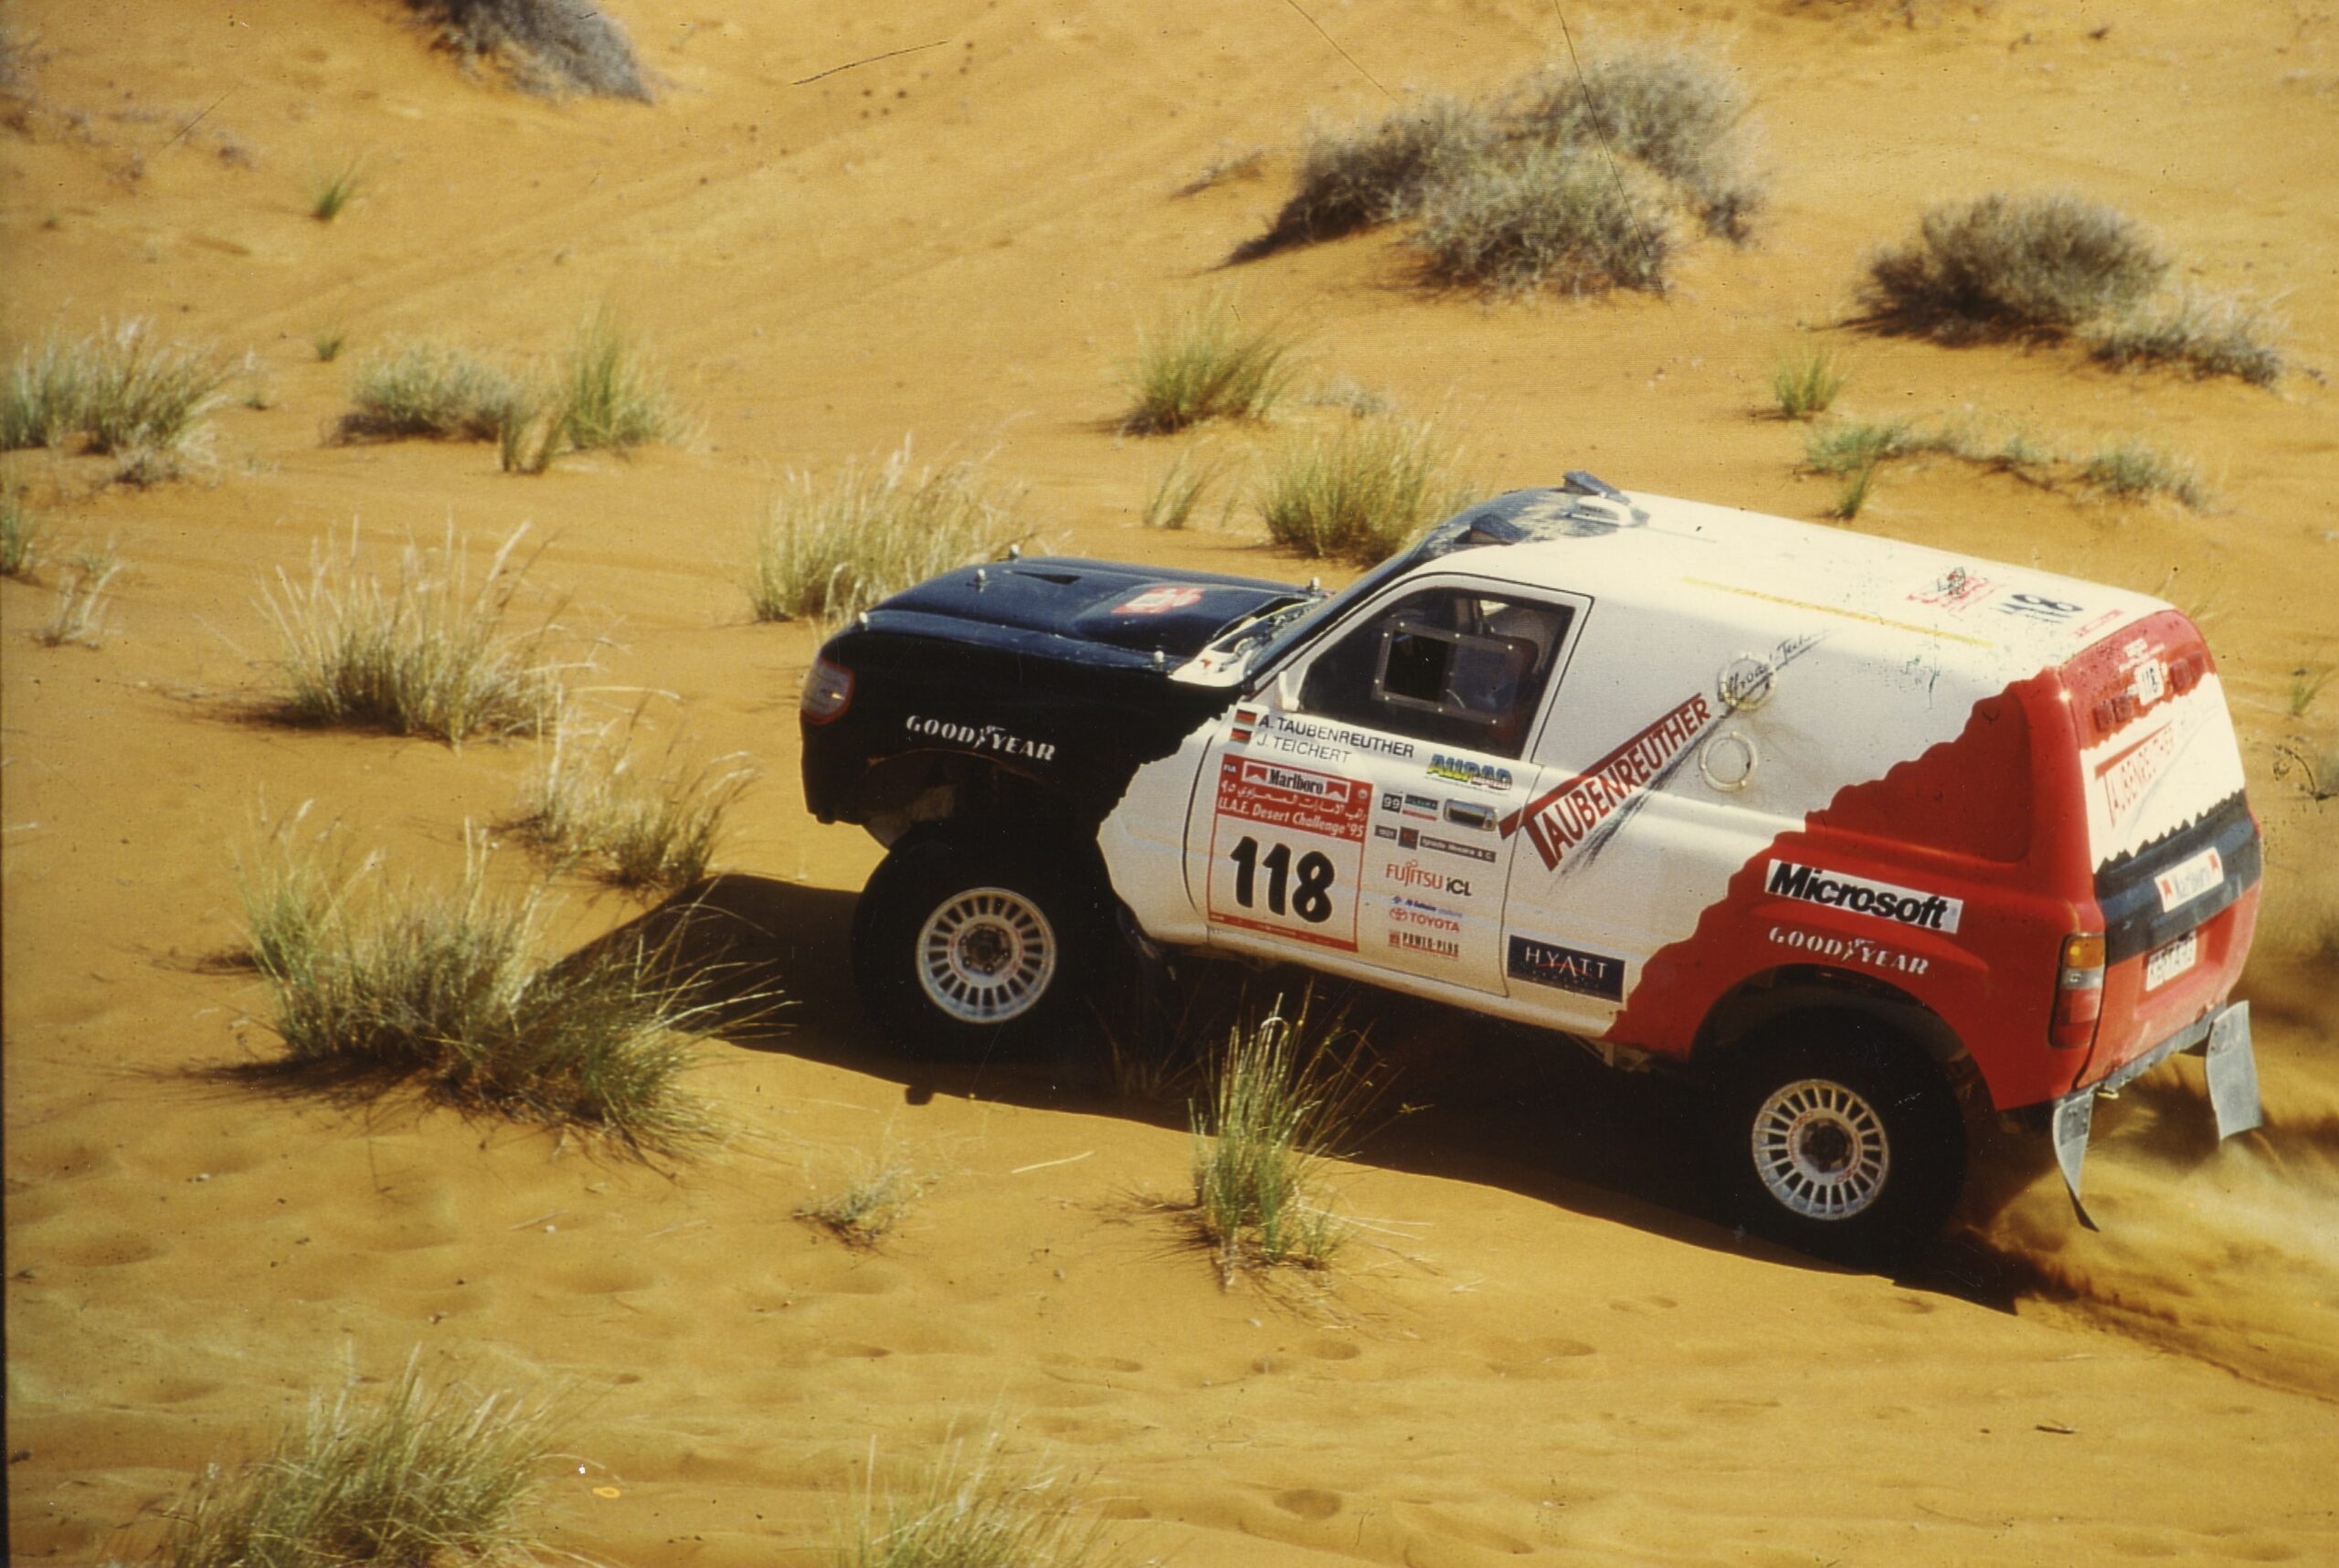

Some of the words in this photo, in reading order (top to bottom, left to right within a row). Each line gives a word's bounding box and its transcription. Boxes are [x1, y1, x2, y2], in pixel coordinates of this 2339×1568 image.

[905, 715, 1056, 763] GOODYEAR
[1256, 734, 1269, 747] J.
[1273, 736, 1352, 764] TEICHERT
[1258, 715, 1274, 729] A.
[1276, 717, 1414, 758] TAUBENREUTHER
[1269, 769, 1325, 795] Marlboro
[1499, 692, 1711, 873] TAUBENREUTHER
[1252, 803, 1290, 823] Desert
[1292, 811, 1346, 838] Challenge
[1347, 823, 1365, 838] '95
[1382, 796, 1401, 810] 99
[1230, 835, 1335, 923] 118
[1385, 859, 1444, 890] FUJITSU
[1768, 863, 1948, 929] Microsoft
[1409, 912, 1460, 933] TOYOTA
[1525, 947, 1608, 979] HYATT
[1769, 926, 1930, 975] GOODYEAR
